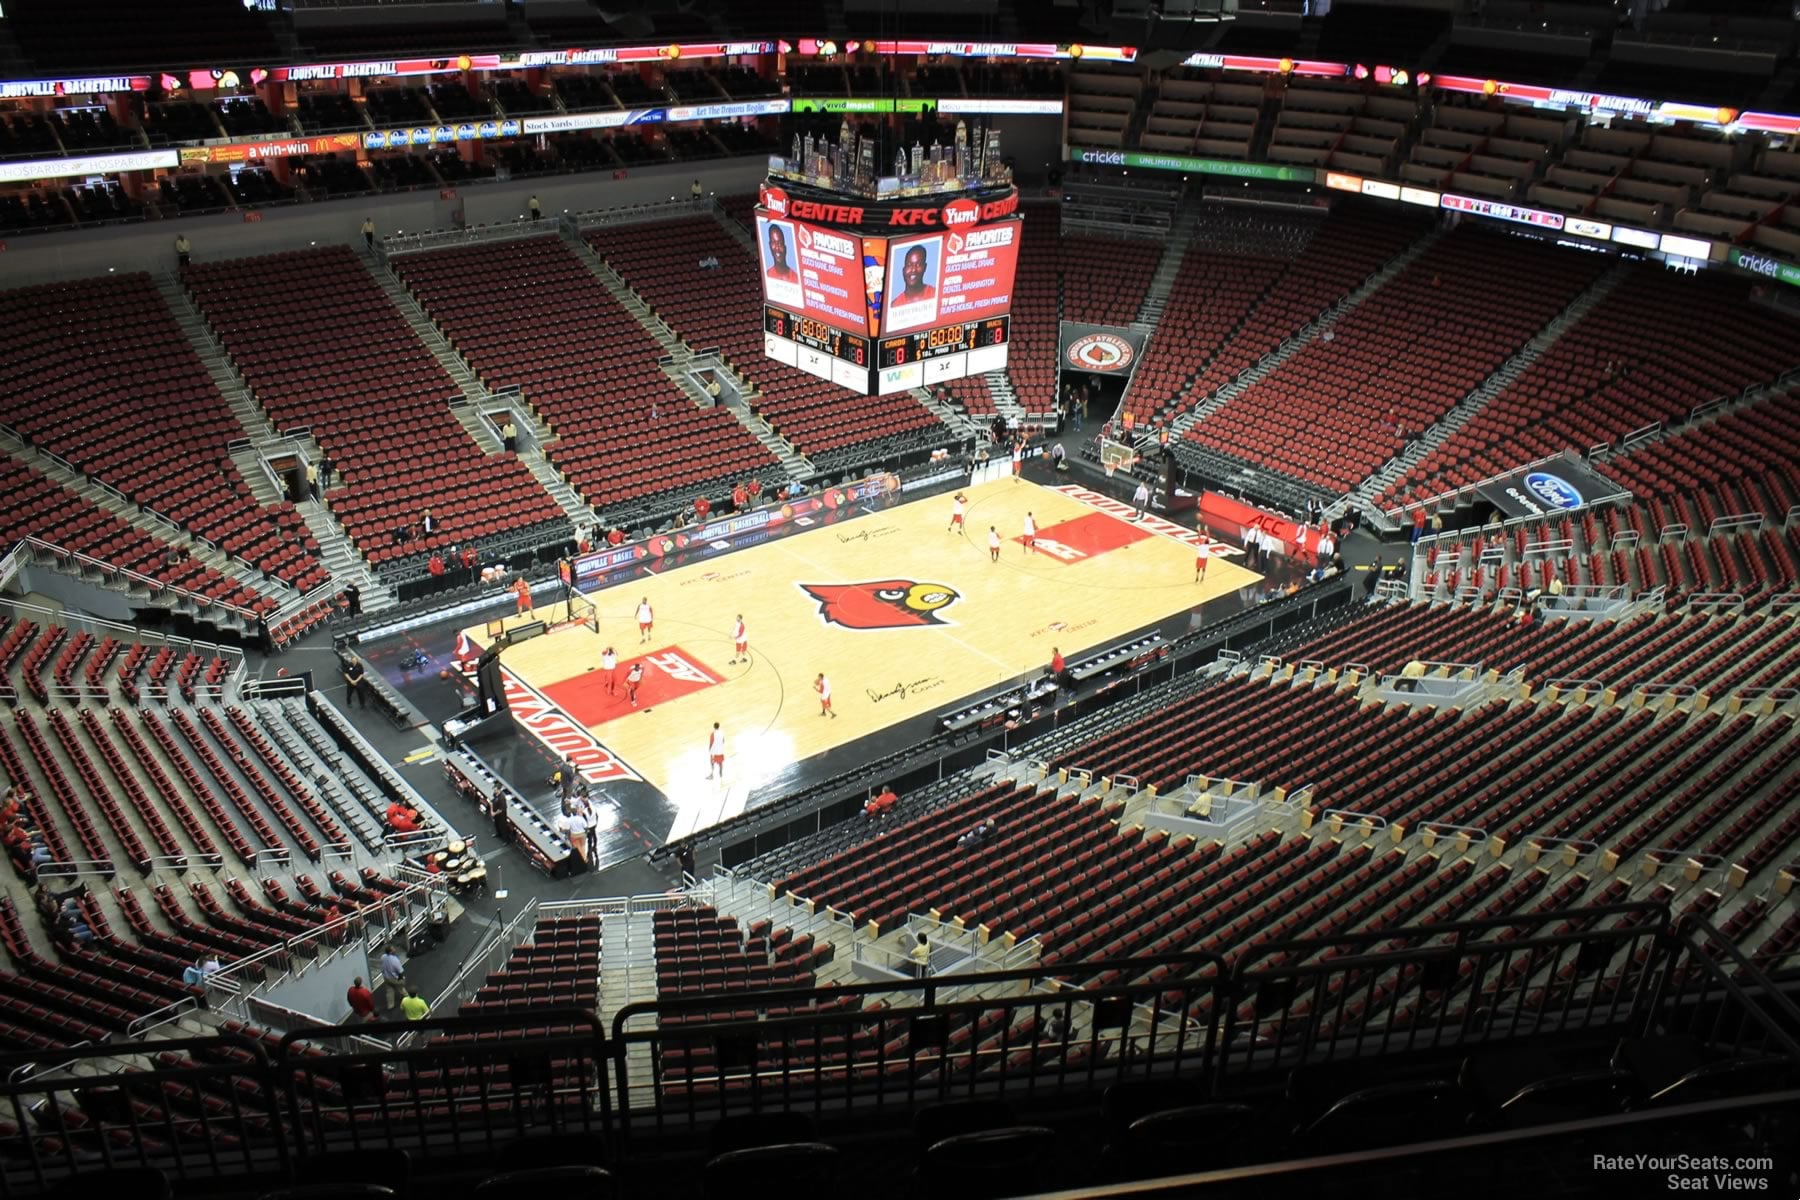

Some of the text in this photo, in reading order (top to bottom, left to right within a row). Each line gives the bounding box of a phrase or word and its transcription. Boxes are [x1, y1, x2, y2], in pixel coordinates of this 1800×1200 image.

[527, 50, 617, 65] LOUISVILLE BASKETBALL
[288, 62, 397, 79] LOUISVILLE BASKETBALL
[64, 77, 131, 94] BASKETBALL
[721, 104, 745, 114] Dreams
[526, 122, 549, 132] Stock
[550, 120, 573, 129] Yards
[249, 148, 257, 158] a
[258, 142, 309, 157] win-win
[4, 163, 68, 177] HOSPARUS
[89, 156, 150, 171] HOSPARUS
[1082, 150, 1126, 166] cricket
[1139, 156, 1182, 168] UNLIMITED
[1238, 166, 1262, 175] DATA
[765, 193, 864, 224] Yum! CENTER
[888, 208, 938, 225] KFC
[945, 205, 978, 225] Yum!
[966, 227, 1013, 249] FAVORITES
[1738, 255, 1778, 278] cricket
[802, 319, 828, 341] 60:00
[930, 326, 962, 346] 60:00
[995, 328, 1002, 343] 0
[896, 347, 904, 364] 0
[1531, 479, 1573, 505] Ford
[699, 514, 769, 539] LOUISVILLE BASKETBALL
[1247, 515, 1285, 535] ACC
[646, 652, 717, 684] ACC
